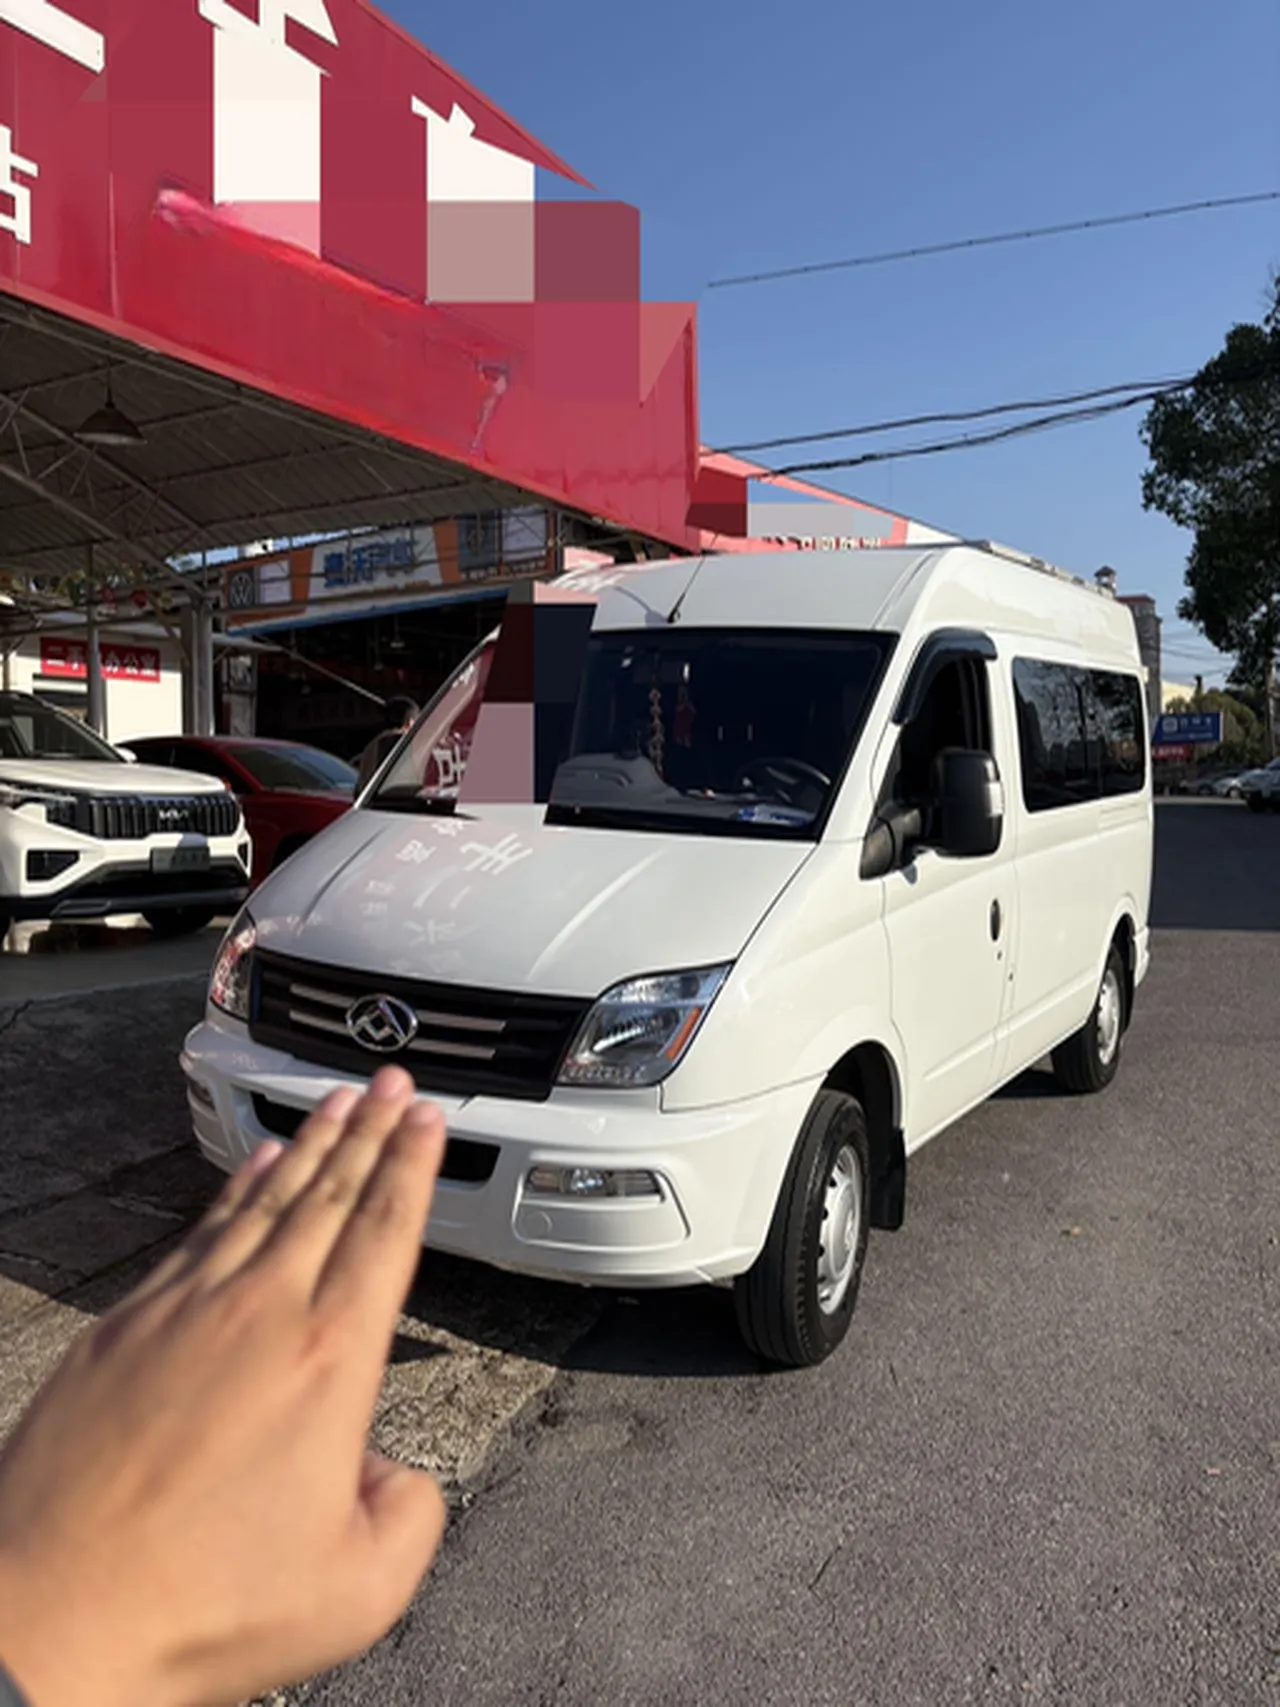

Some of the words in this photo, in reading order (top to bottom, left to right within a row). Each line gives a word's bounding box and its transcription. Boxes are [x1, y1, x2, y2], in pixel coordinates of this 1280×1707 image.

[46, 645, 157, 677] 二手办公室
